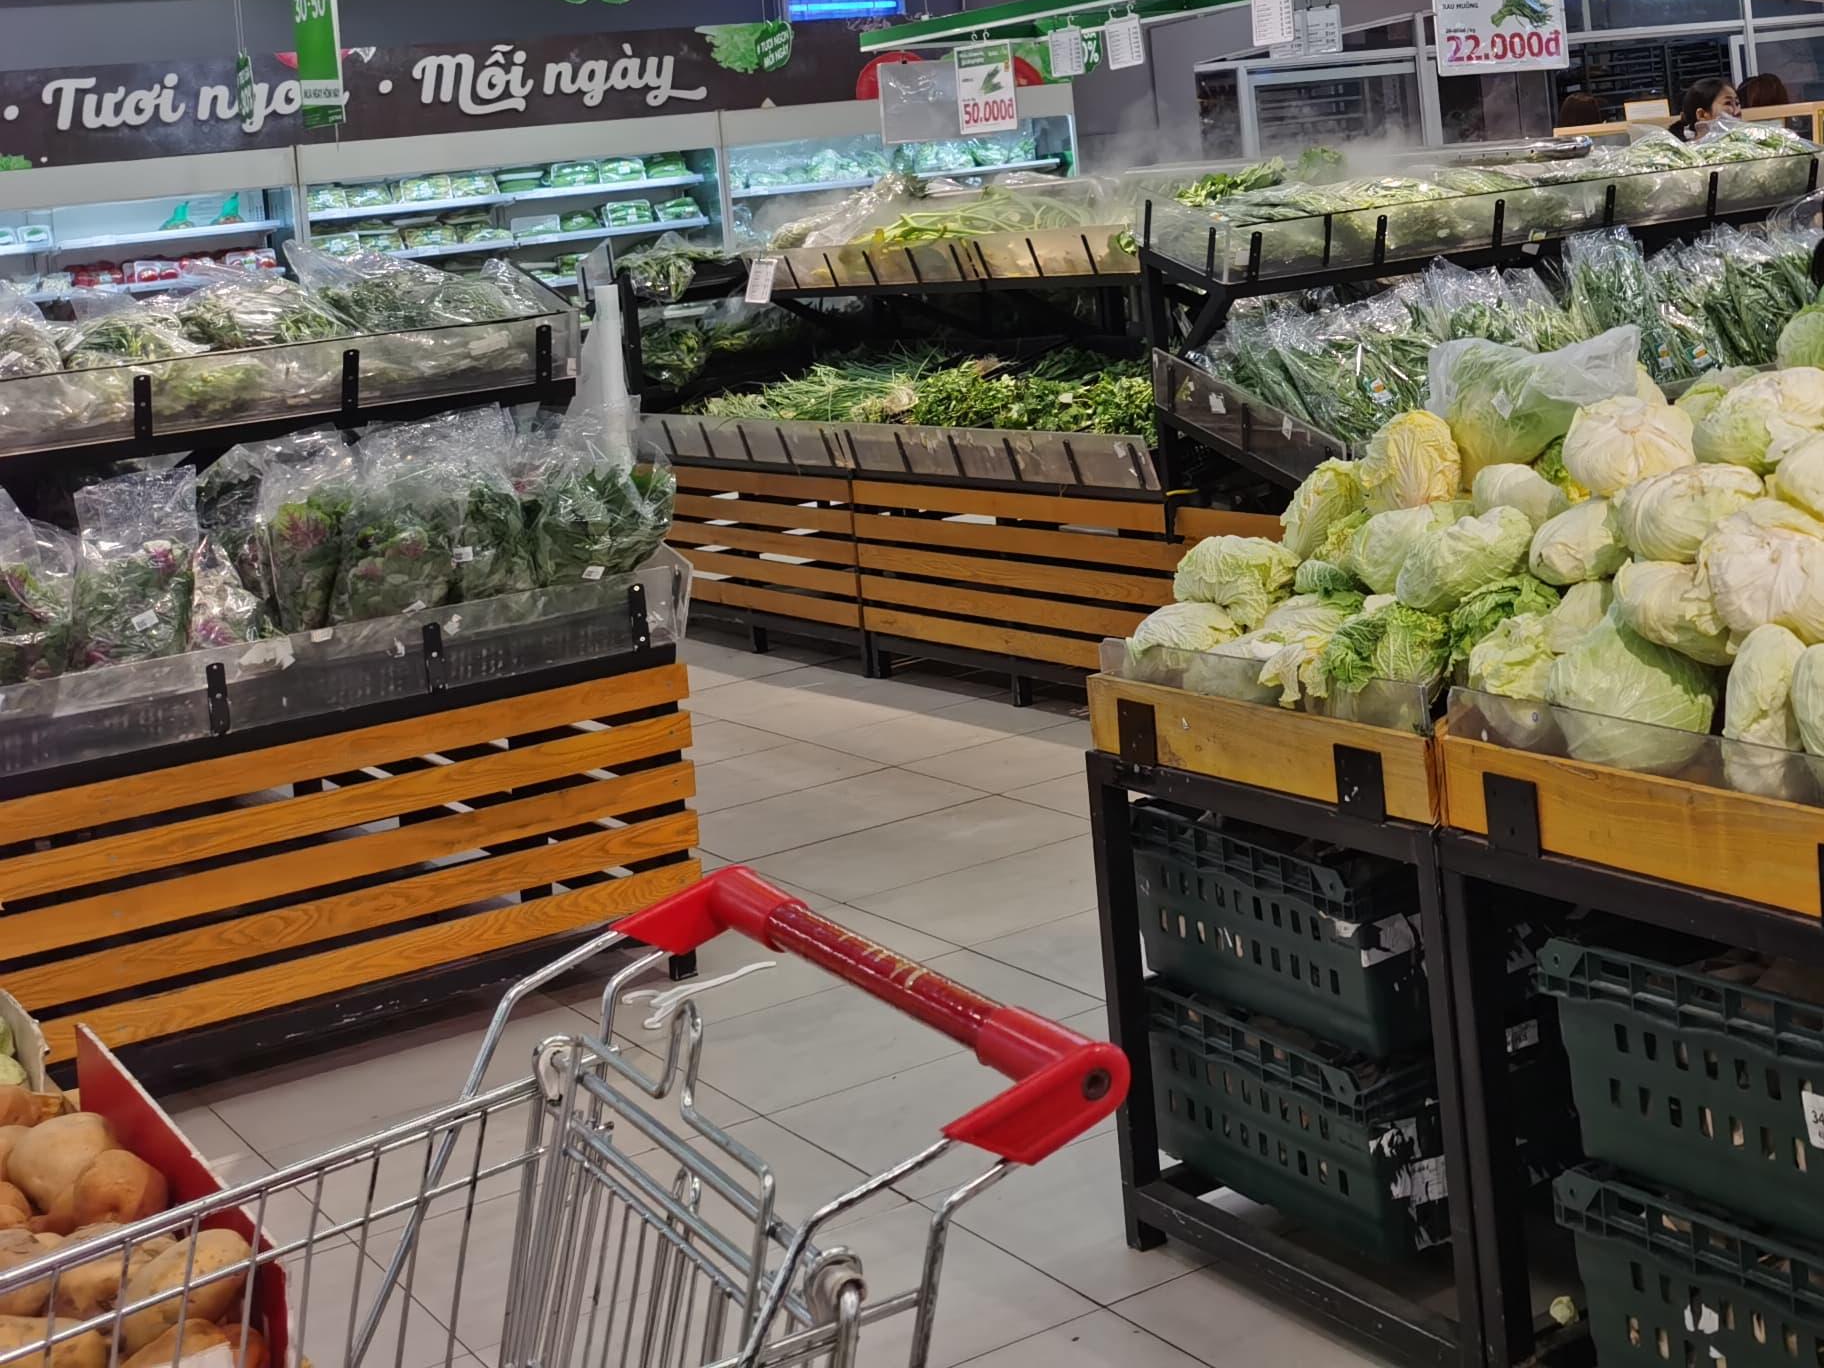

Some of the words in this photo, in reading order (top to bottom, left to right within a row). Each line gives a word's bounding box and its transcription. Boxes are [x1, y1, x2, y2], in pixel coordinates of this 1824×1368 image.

[1446, 29, 1561, 62] 22.000đ
[41, 73, 185, 130] Tươi
[196, 79, 348, 133] ngo
[412, 44, 534, 115] Mỗi
[543, 42, 708, 107] ngày
[963, 97, 1014, 125] 50.000đ
